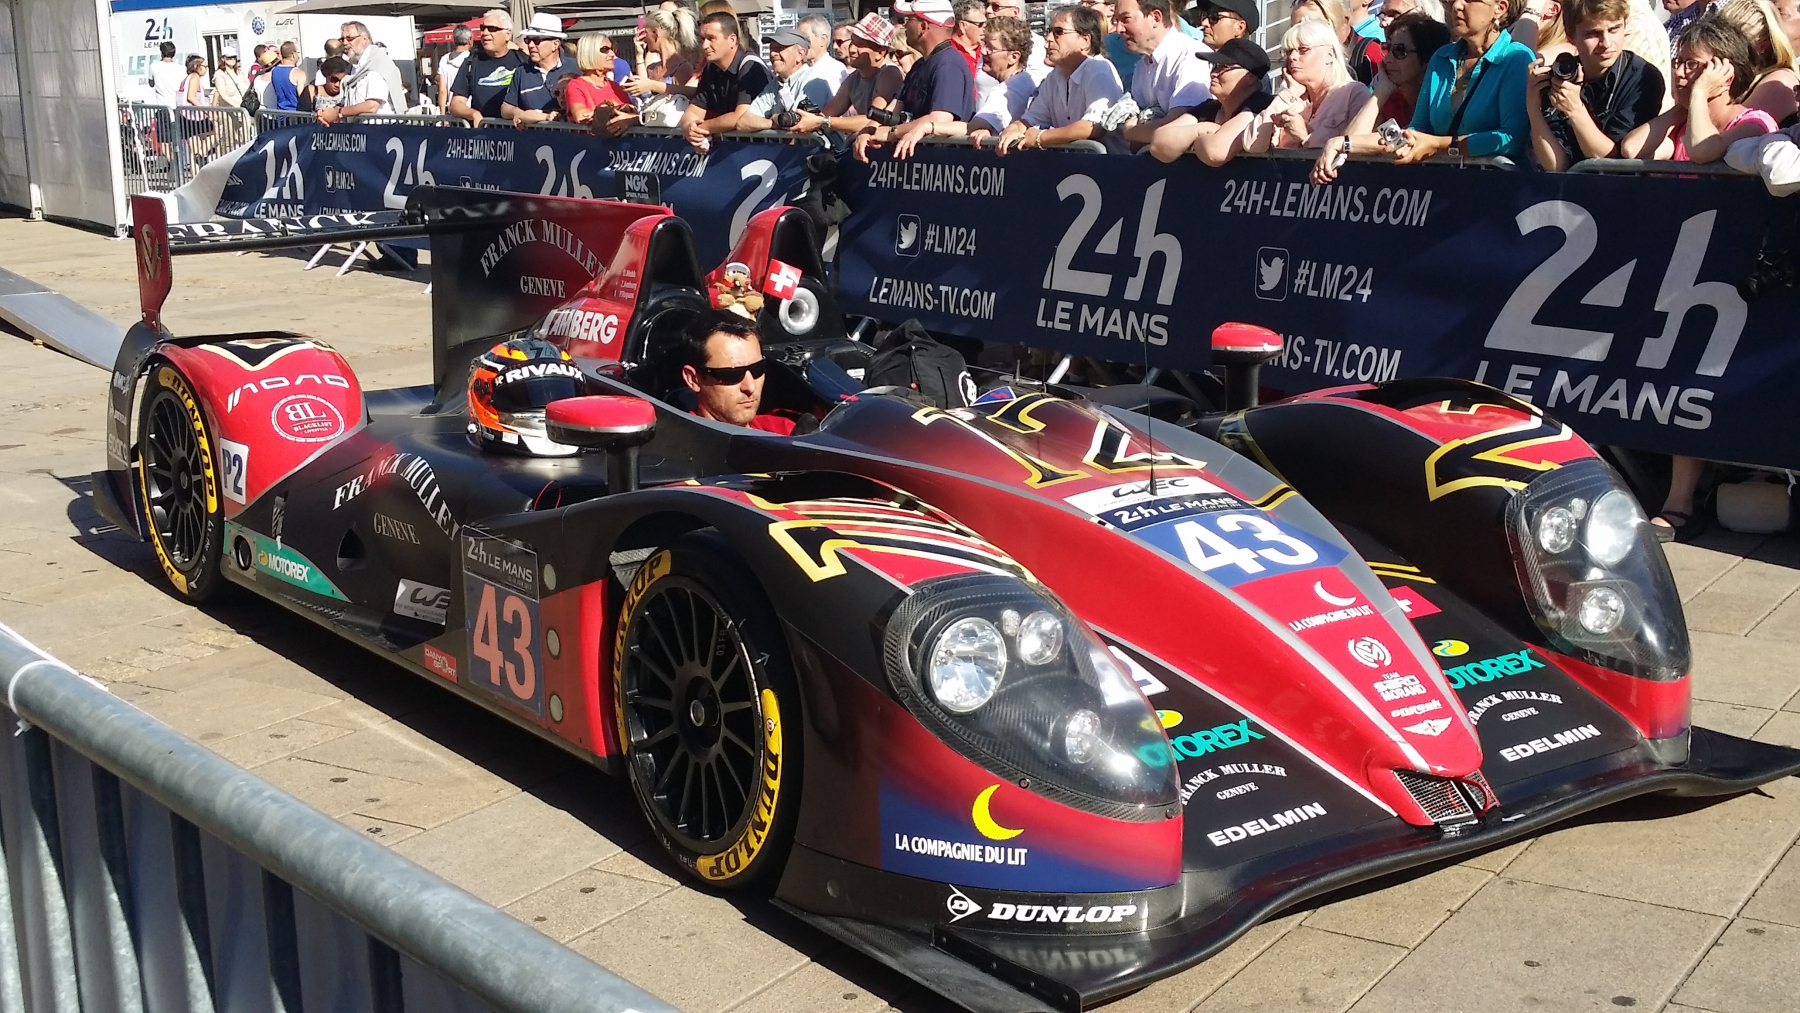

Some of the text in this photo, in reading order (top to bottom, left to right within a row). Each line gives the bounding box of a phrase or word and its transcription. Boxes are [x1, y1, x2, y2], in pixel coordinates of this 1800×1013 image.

[145, 17, 173, 40] 24h
[311, 132, 367, 152] 24H-LEMANS.COM
[446, 138, 514, 162] 24H-LEMANS.COM
[604, 150, 710, 178] 24H-LEMANS.COM
[868, 160, 1005, 196] 24H-LEMANS.COM
[625, 174, 649, 192] NGK
[254, 203, 267, 218] LE
[269, 204, 305, 218] MANS
[1220, 179, 1432, 227] 24H-LEMANS.COM
[480, 219, 537, 278] FRANCK
[925, 223, 976, 256] #LM24
[1042, 173, 1183, 306] 24h
[520, 275, 566, 299] GENEVE
[1294, 260, 1374, 303] #LM24
[1484, 200, 1748, 377] 24h
[869, 276, 996, 320] LEMANS-TV.COM
[1036, 298, 1169, 346] LE MANS
[505, 363, 584, 383] RIVAUX
[1270, 334, 1402, 382] NS-TV.COM
[1551, 369, 1715, 430] MANS
[293, 421, 333, 433] BLACKLIST
[222, 448, 244, 496] P2
[332, 453, 412, 511] FRANCK
[1112, 477, 1190, 498] WEC
[1114, 506, 1158, 525] 24h
[1159, 503, 1184, 514] LE
[1184, 496, 1239, 509] MANS
[373, 513, 420, 545] GENEVE
[1174, 513, 1319, 575] 43
[268, 553, 310, 583] MOTOREX
[467, 537, 487, 564] 24h
[488, 557, 501, 570] LE
[502, 559, 533, 583] MANS
[473, 583, 535, 700] 43
[1288, 620, 1306, 632] LA
[424, 648, 441, 662] DANY
[1443, 650, 1546, 690] OTOREX
[1382, 672, 1400, 680] TEAM
[1379, 684, 1427, 702] MORAND
[1500, 690, 1564, 704] MULLER
[1502, 706, 1540, 722] GENEVE
[1499, 724, 1602, 762] EDELMIN
[1218, 763, 1288, 777] MULLER
[1216, 782, 1260, 800] GENEVE
[709, 754, 780, 878] DUNLOP
[1207, 801, 1328, 847] EDELMIN
[895, 833, 1028, 866] LA COMPAGNIE DU LIT
[987, 902, 1138, 923] DUNLOP
